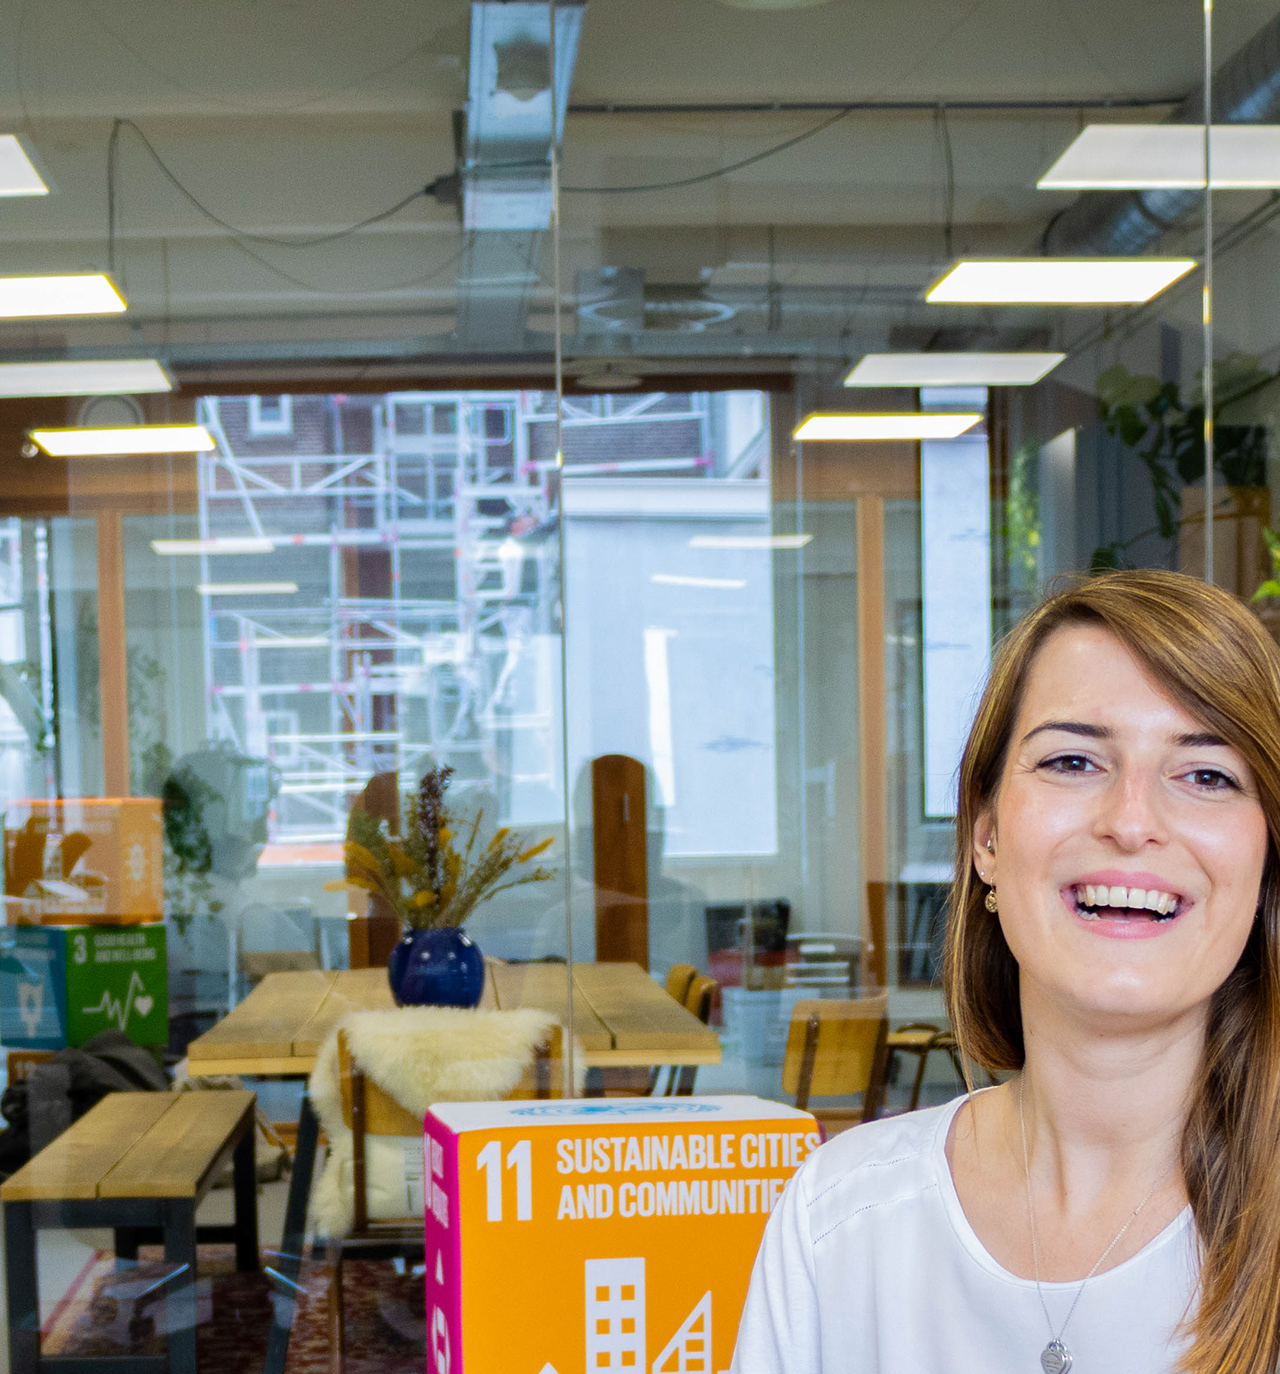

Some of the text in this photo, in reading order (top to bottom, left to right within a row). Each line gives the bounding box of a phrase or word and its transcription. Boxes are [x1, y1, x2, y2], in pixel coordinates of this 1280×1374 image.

[73, 934, 88, 964] 3
[556, 1131, 821, 1174] SUSTAINABLE CITIES
[476, 1140, 532, 1222] 11
[557, 1178, 790, 1220] AND COMMUNITIE
